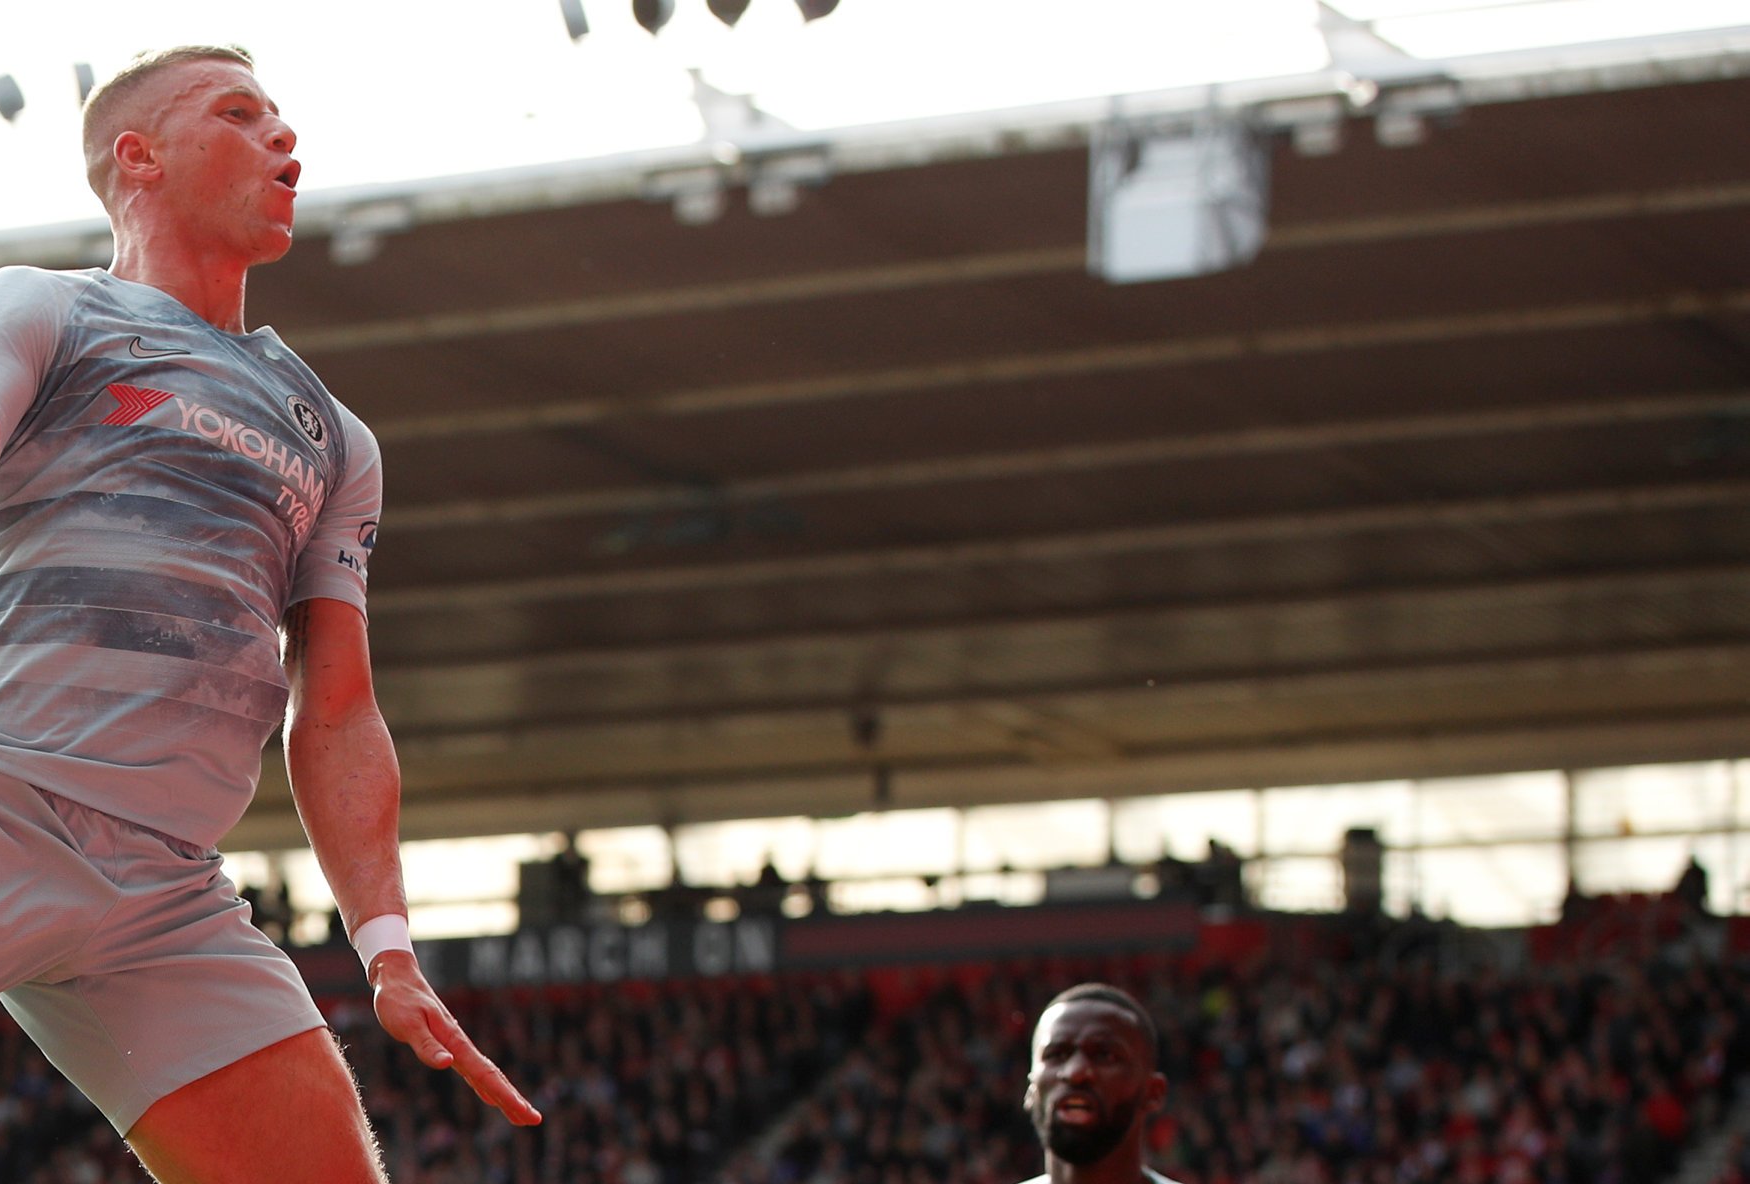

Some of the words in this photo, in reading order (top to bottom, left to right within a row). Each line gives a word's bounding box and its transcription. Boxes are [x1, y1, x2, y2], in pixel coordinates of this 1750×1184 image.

[176, 397, 325, 514] YOKOHAM
[467, 922, 669, 985] MARCH
[694, 917, 775, 977] ON
